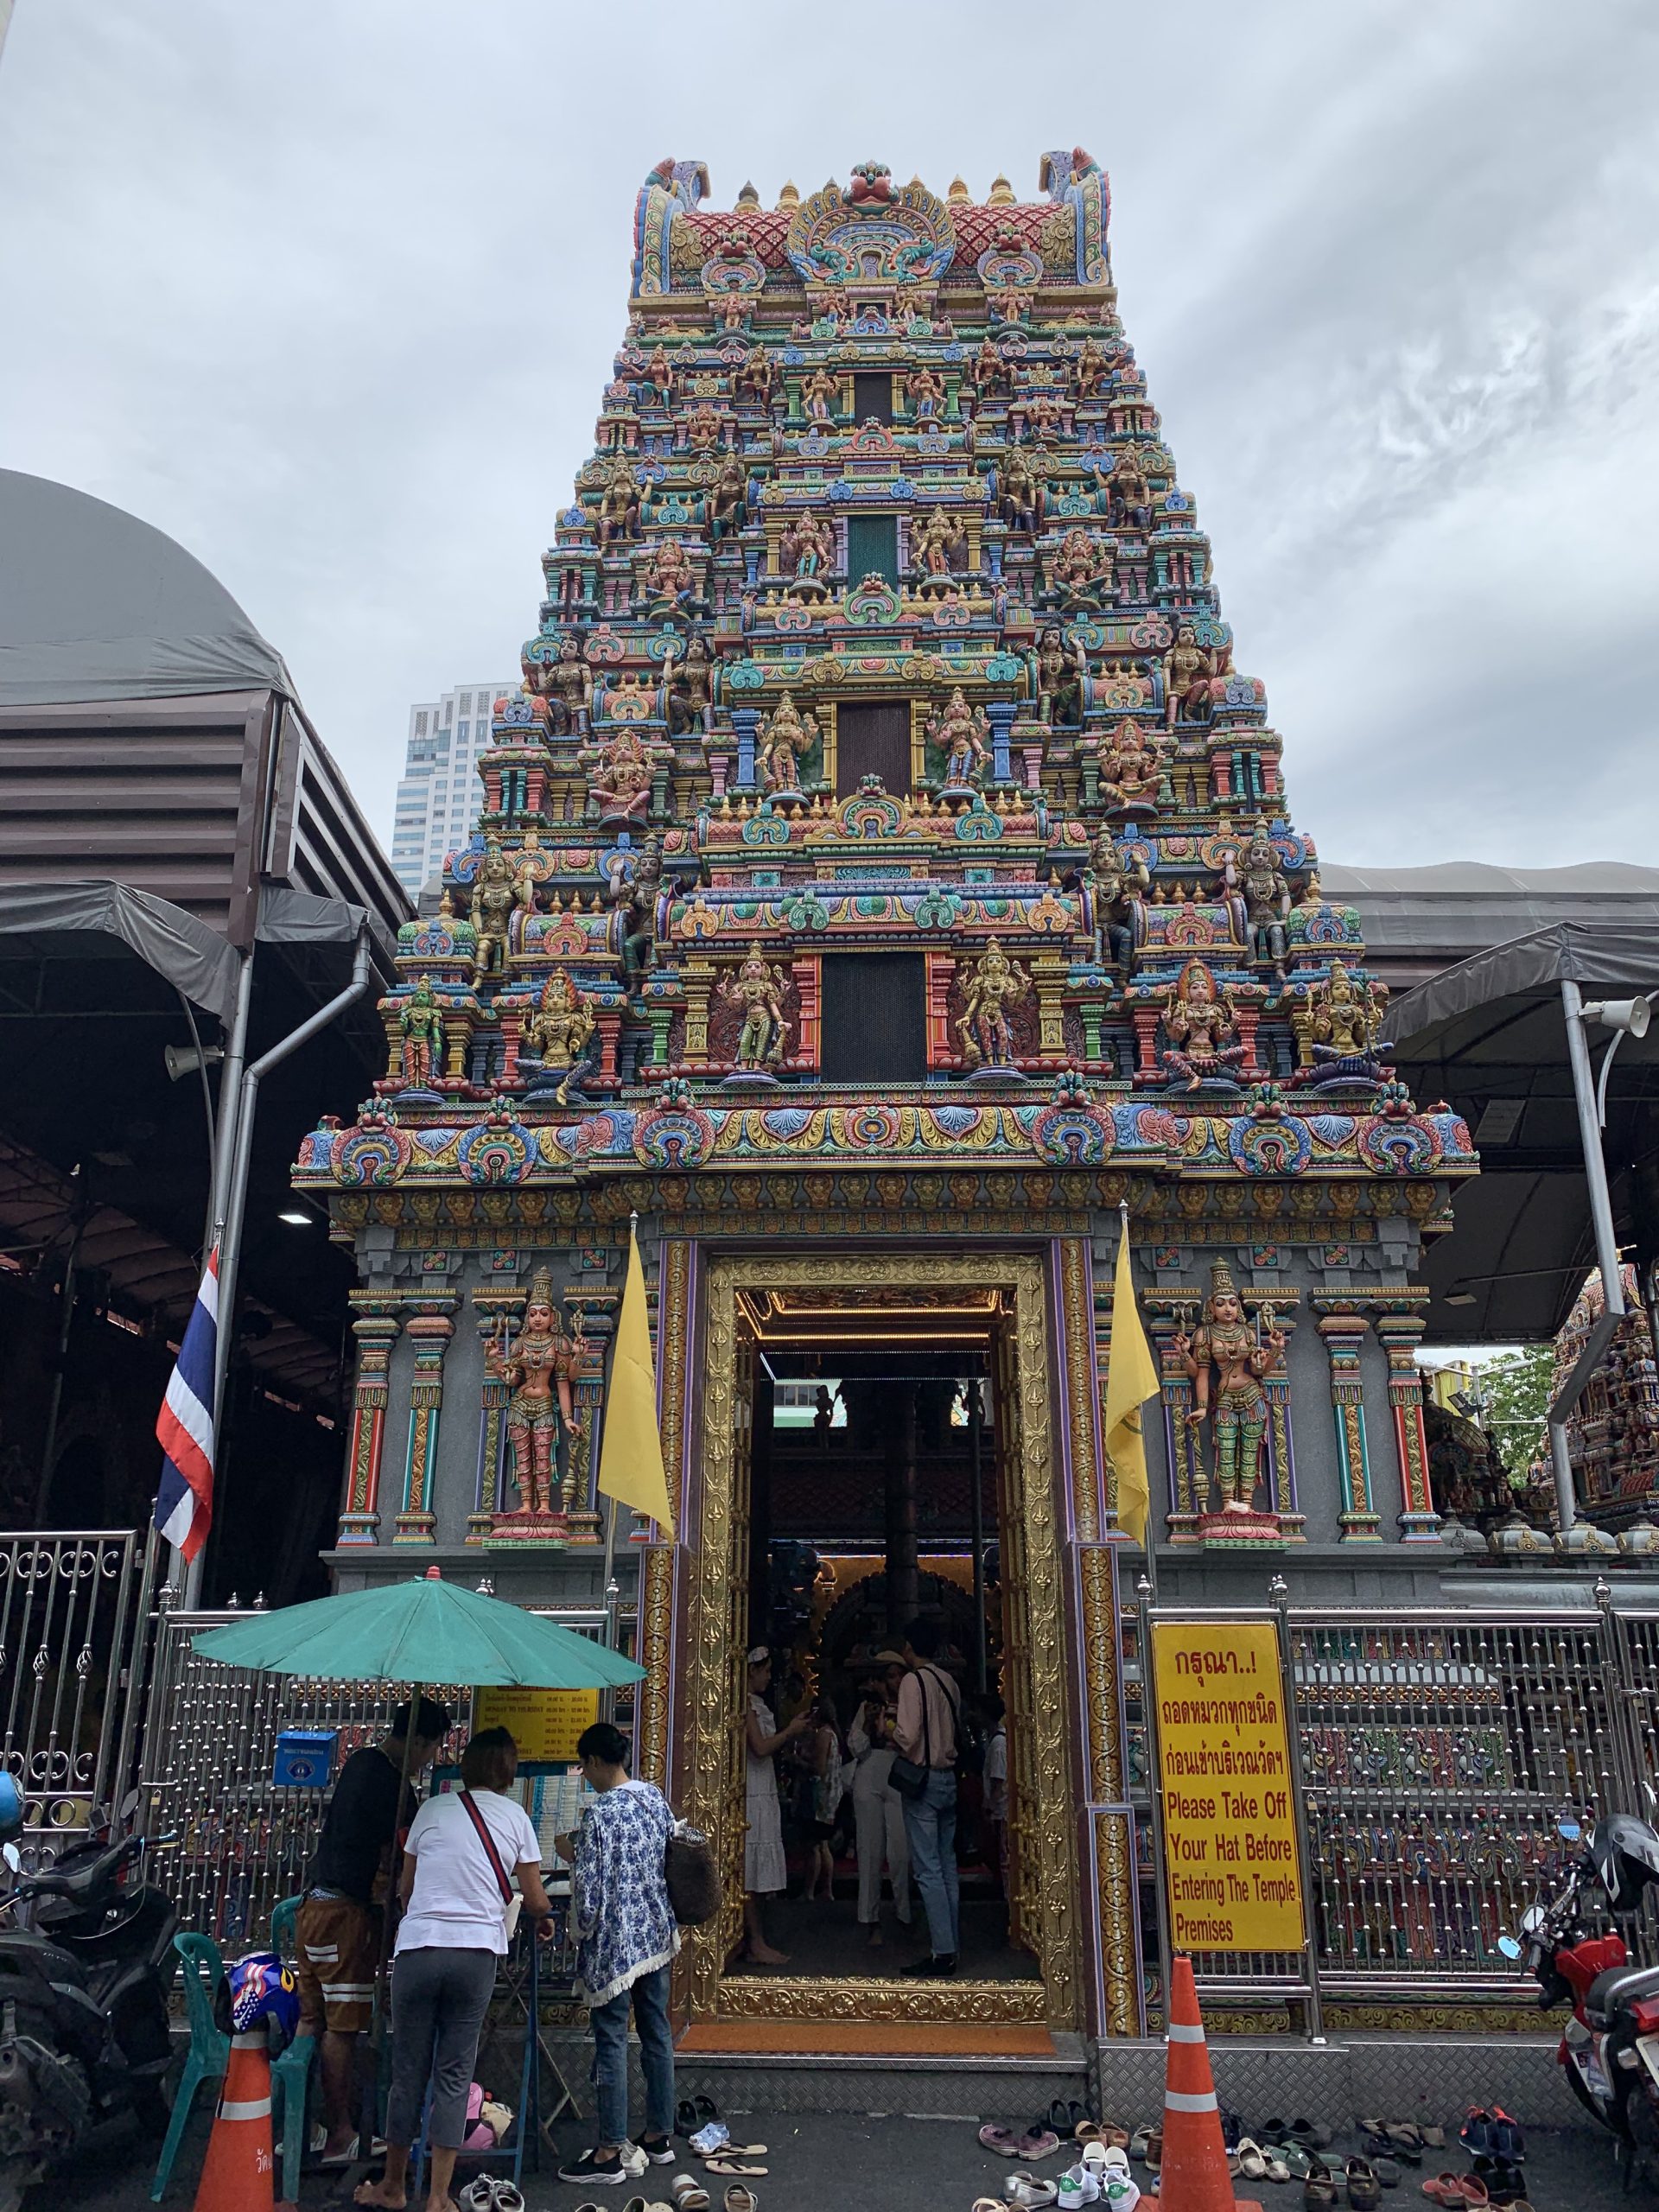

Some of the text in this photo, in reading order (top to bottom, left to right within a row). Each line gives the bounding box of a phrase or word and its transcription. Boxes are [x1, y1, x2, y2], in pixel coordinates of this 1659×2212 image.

[1175, 1651, 1256, 1688] กรุณา..!
[1162, 1692, 1277, 1737] ถอดหมวกทุกชนิด
[1166, 1739, 1283, 1776] ก่อนเข้าบริเวณวัดฯ
[1167, 1791, 1287, 1820] Please Take Off
[1170, 1833, 1292, 1861] Your Hat Before
[1172, 1872, 1295, 1908] Entering The Temple
[1176, 1912, 1233, 1942] Premises
